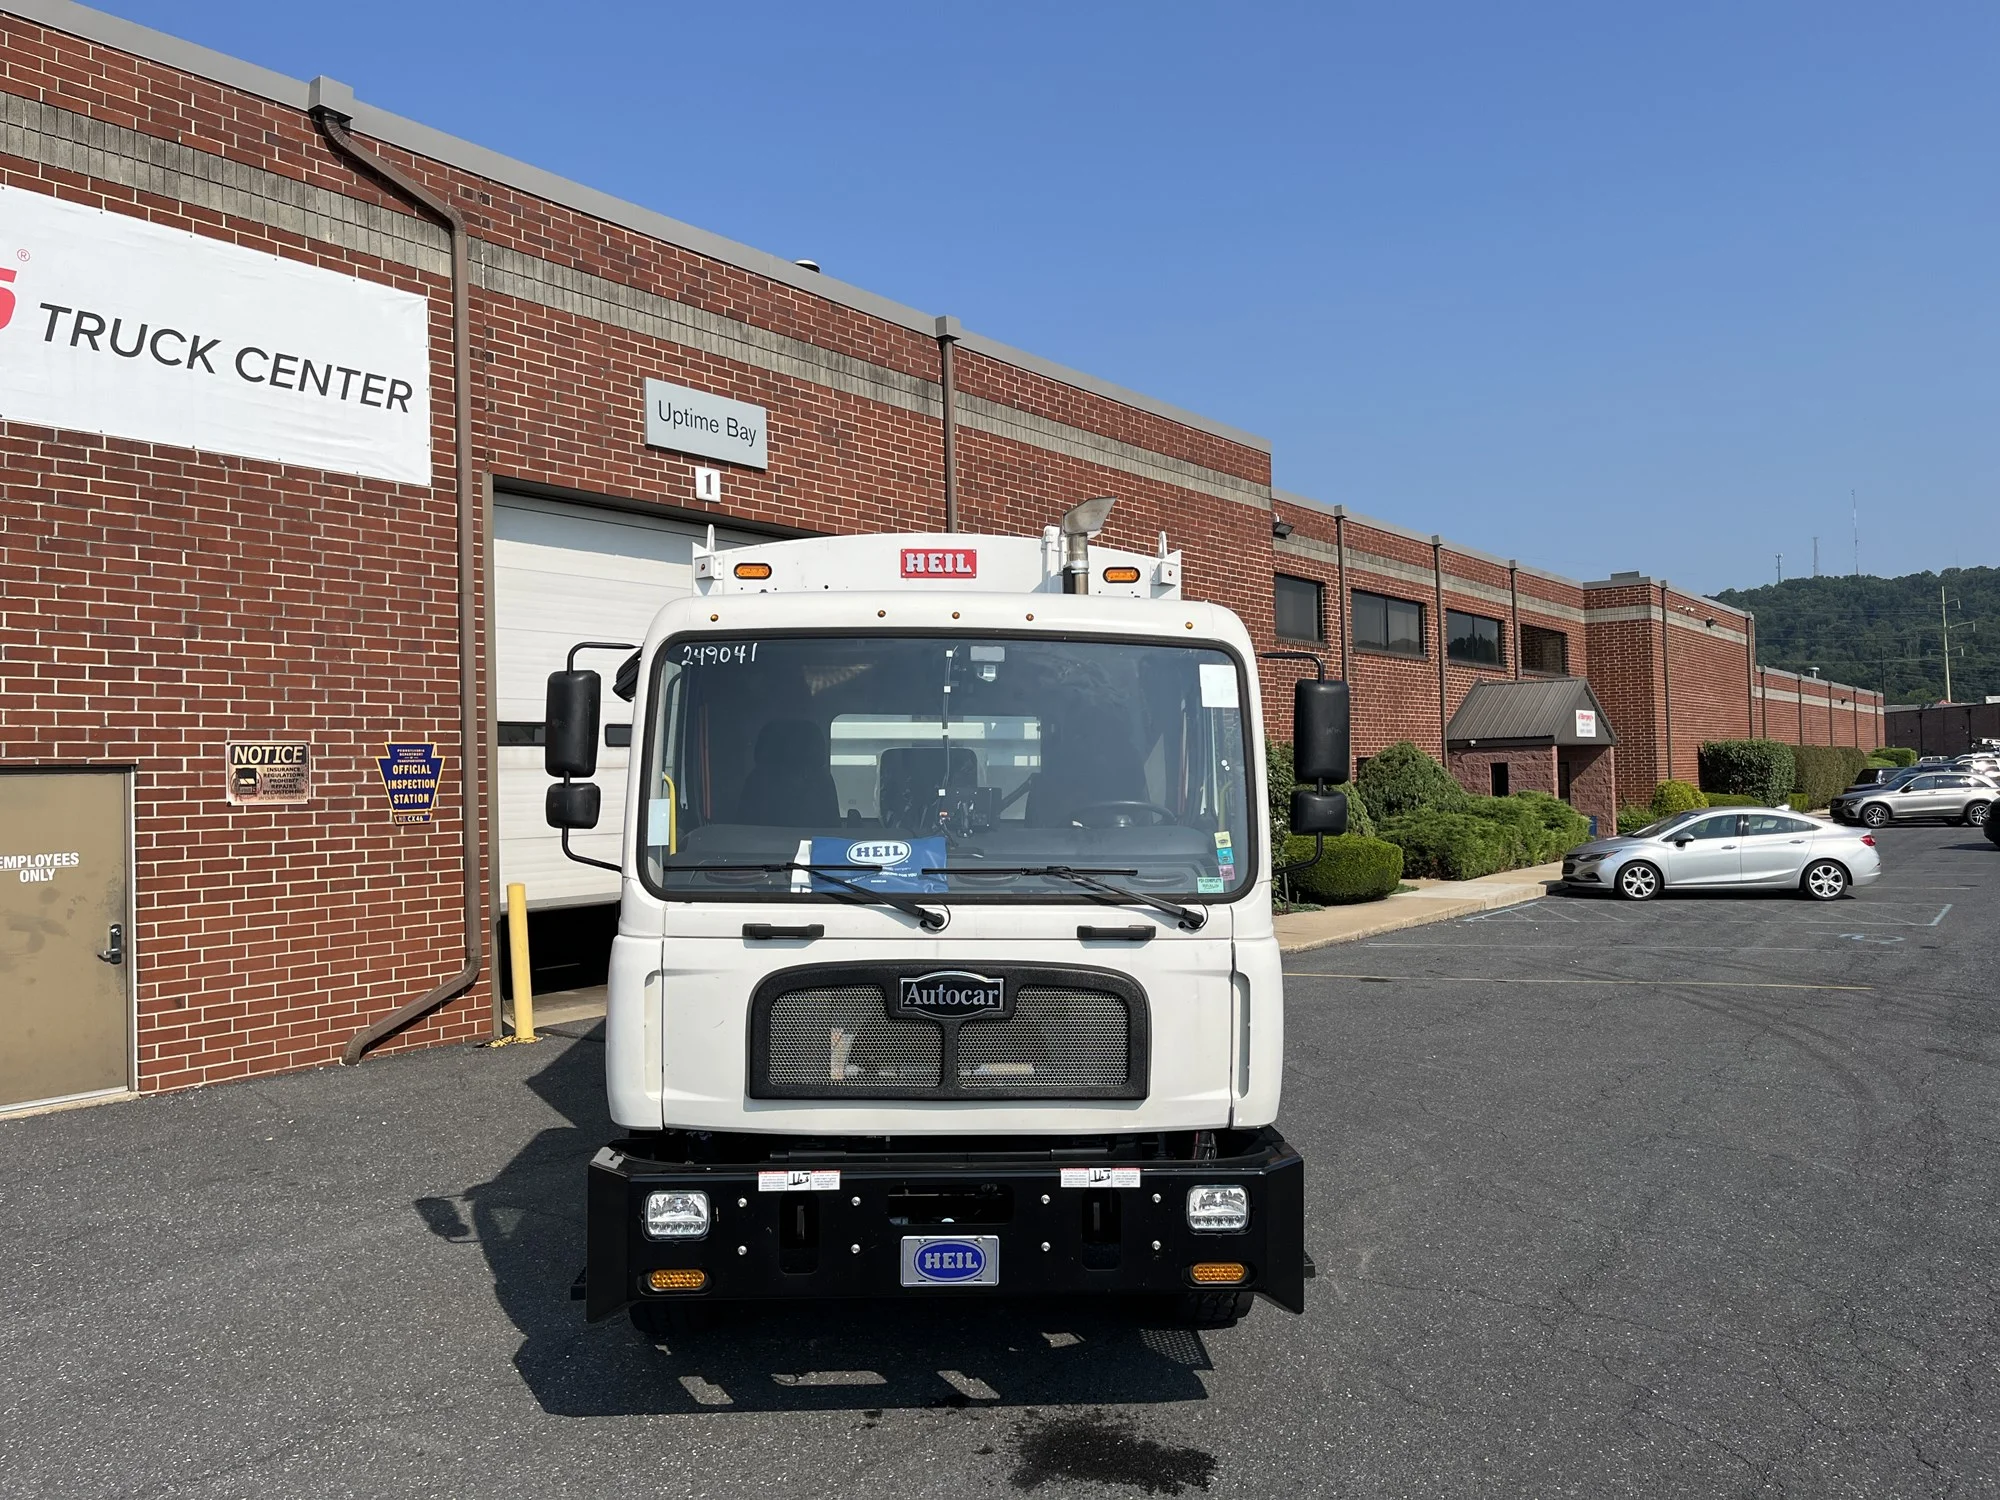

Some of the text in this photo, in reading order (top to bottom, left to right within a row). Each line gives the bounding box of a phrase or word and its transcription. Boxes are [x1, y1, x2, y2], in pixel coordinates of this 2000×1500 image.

[39, 302, 414, 413] TRUCK CENTER
[658, 400, 757, 447] Uptime Bay
[704, 473, 713, 496] 1
[905, 553, 972, 573] HEIL
[681, 642, 758, 666] 249041
[233, 746, 304, 764] NOTICE
[392, 764, 432, 775] OFFICIAL
[388, 779, 436, 790] INSPECTION
[393, 793, 430, 804] STATION
[856, 845, 904, 858] HEIL
[20, 868, 56, 883] ONLY
[904, 983, 999, 1005] Autocar
[924, 1252, 979, 1269] HEIL
